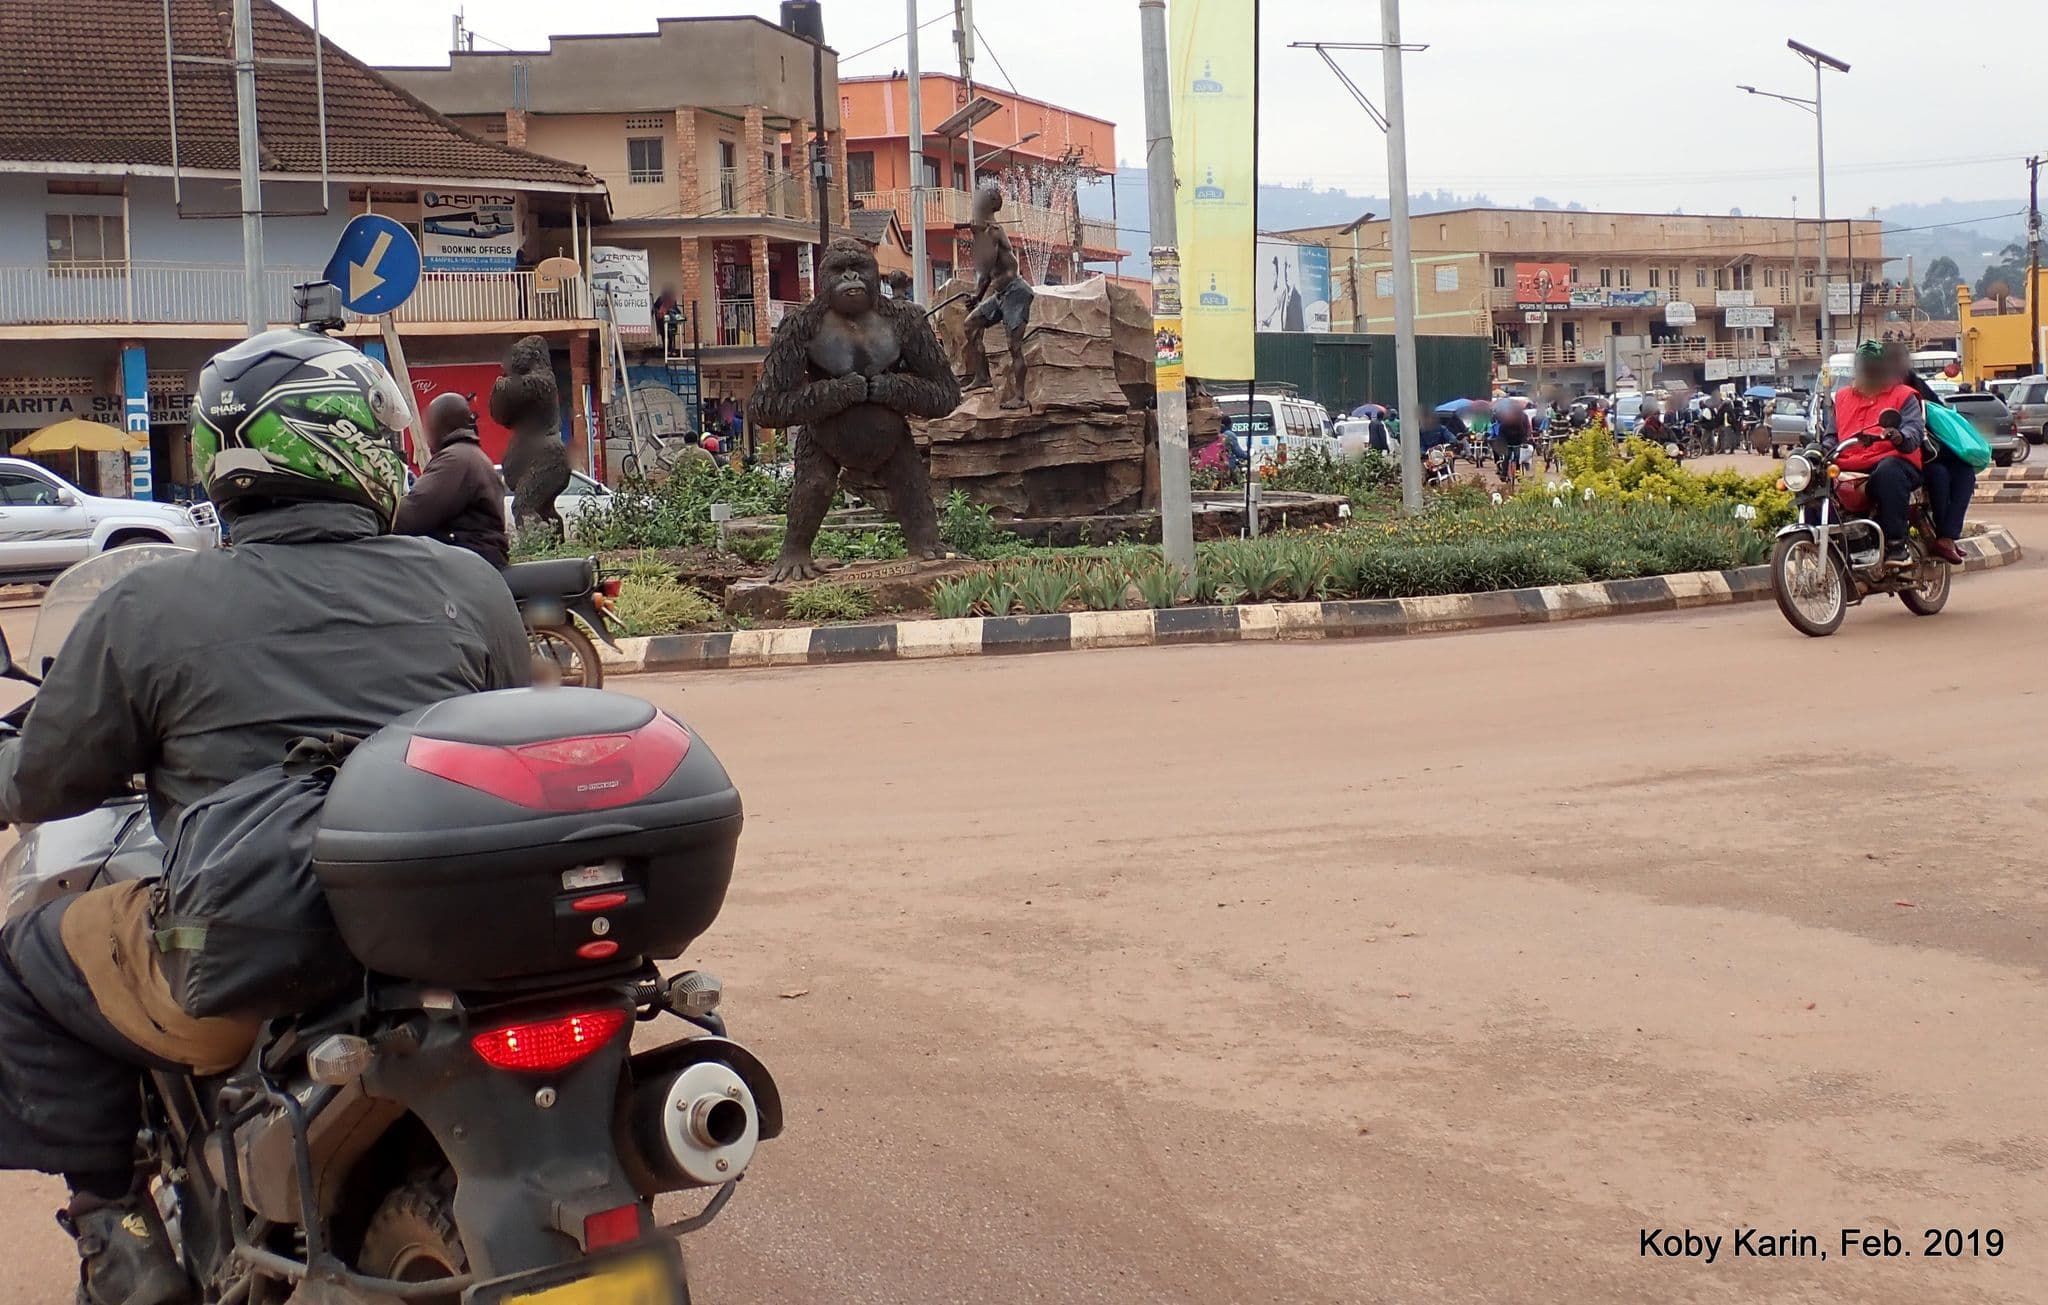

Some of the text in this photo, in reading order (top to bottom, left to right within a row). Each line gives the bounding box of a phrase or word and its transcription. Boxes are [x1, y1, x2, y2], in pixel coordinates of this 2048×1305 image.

[439, 195, 516, 205] TRINITY
[441, 245, 512, 254] BOOKING OFFICES
[605, 253, 644, 261] TRINITY
[624, 299, 648, 307] OFFICES
[210, 403, 247, 415] SHARK
[1231, 422, 1269, 432] SERVICE
[328, 419, 398, 488] SHARK
